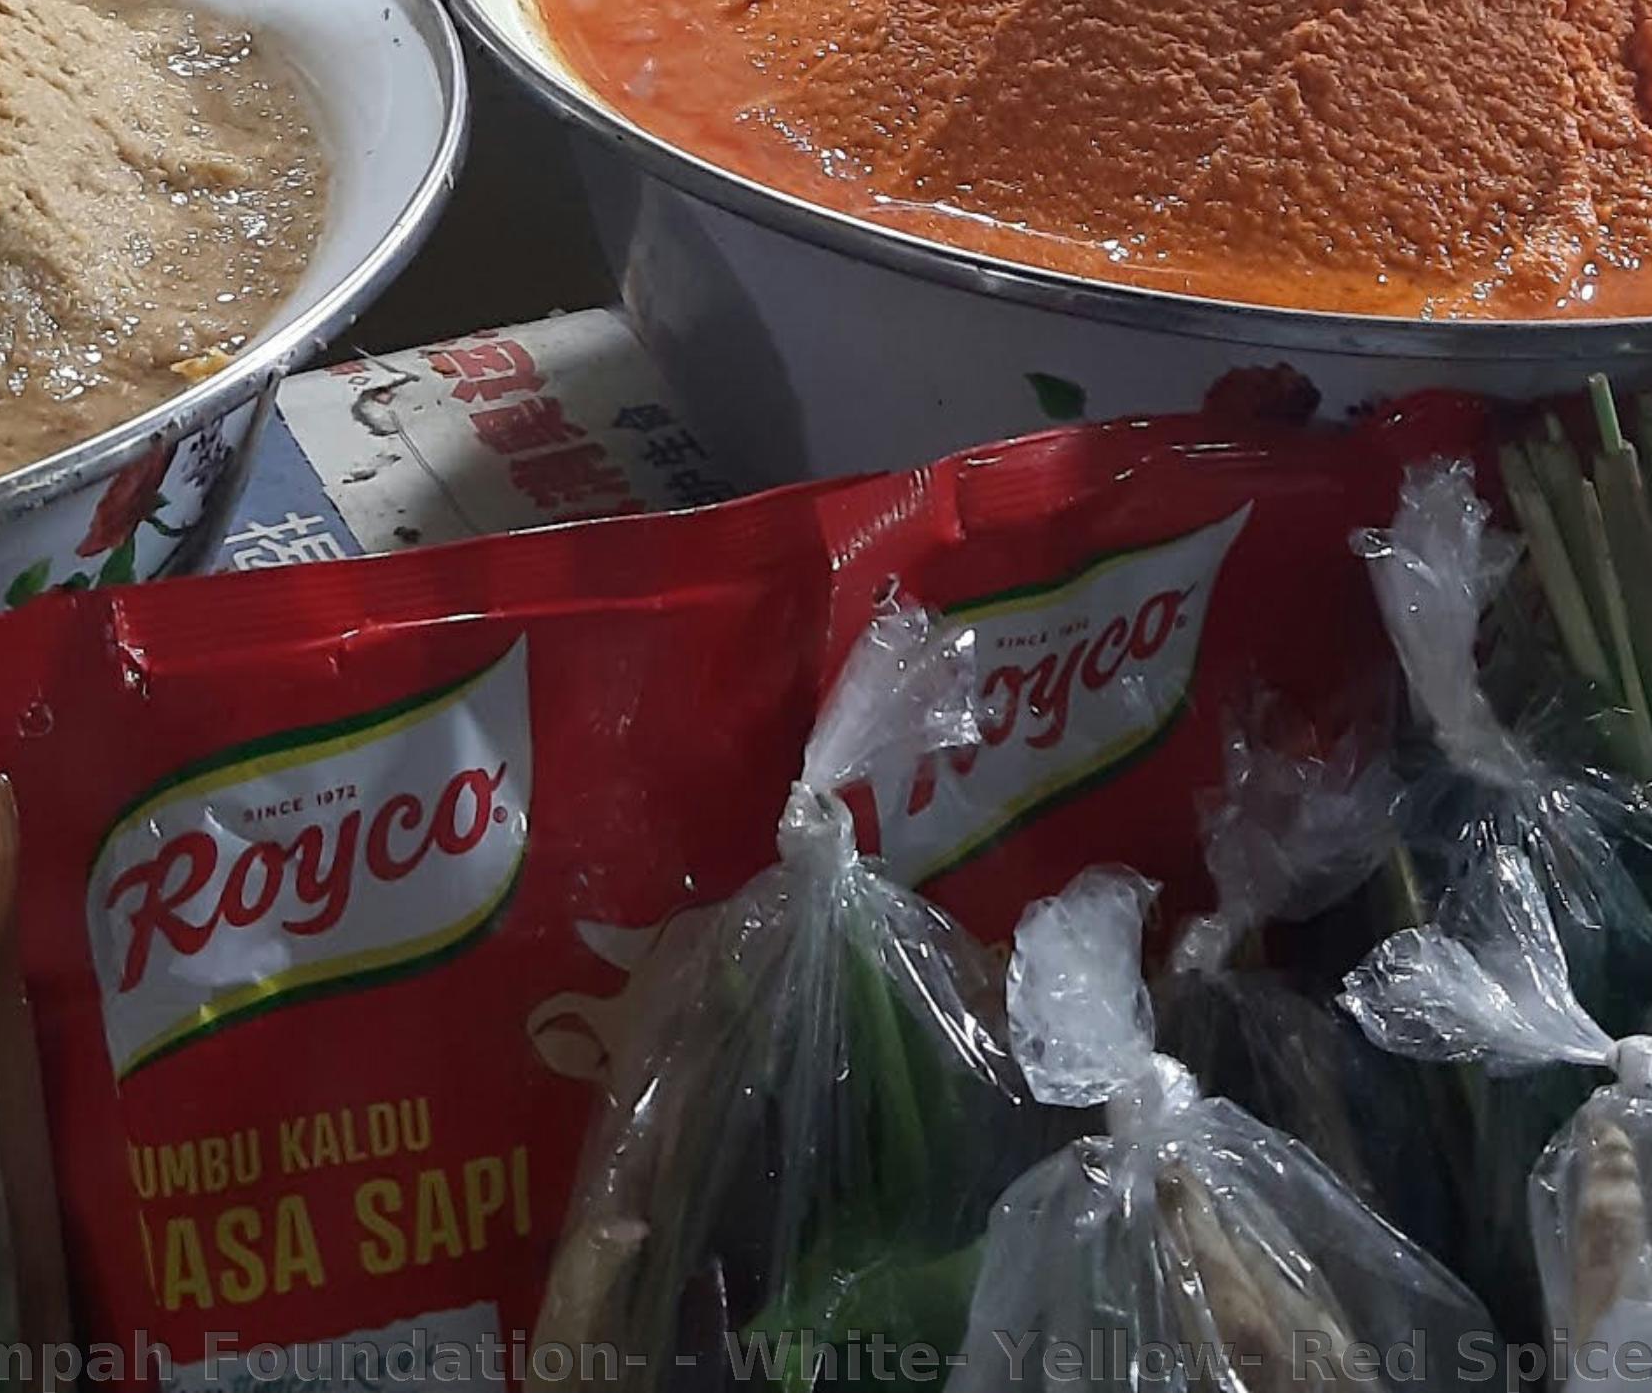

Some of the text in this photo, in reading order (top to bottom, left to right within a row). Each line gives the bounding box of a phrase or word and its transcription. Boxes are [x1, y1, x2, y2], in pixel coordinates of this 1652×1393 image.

[244, 785, 358, 822] SINCE 1972
[106, 761, 508, 993] Royco
[130, 1098, 433, 1199] UMBU KALDU
[140, 1145, 531, 1311] ASA SAPI
